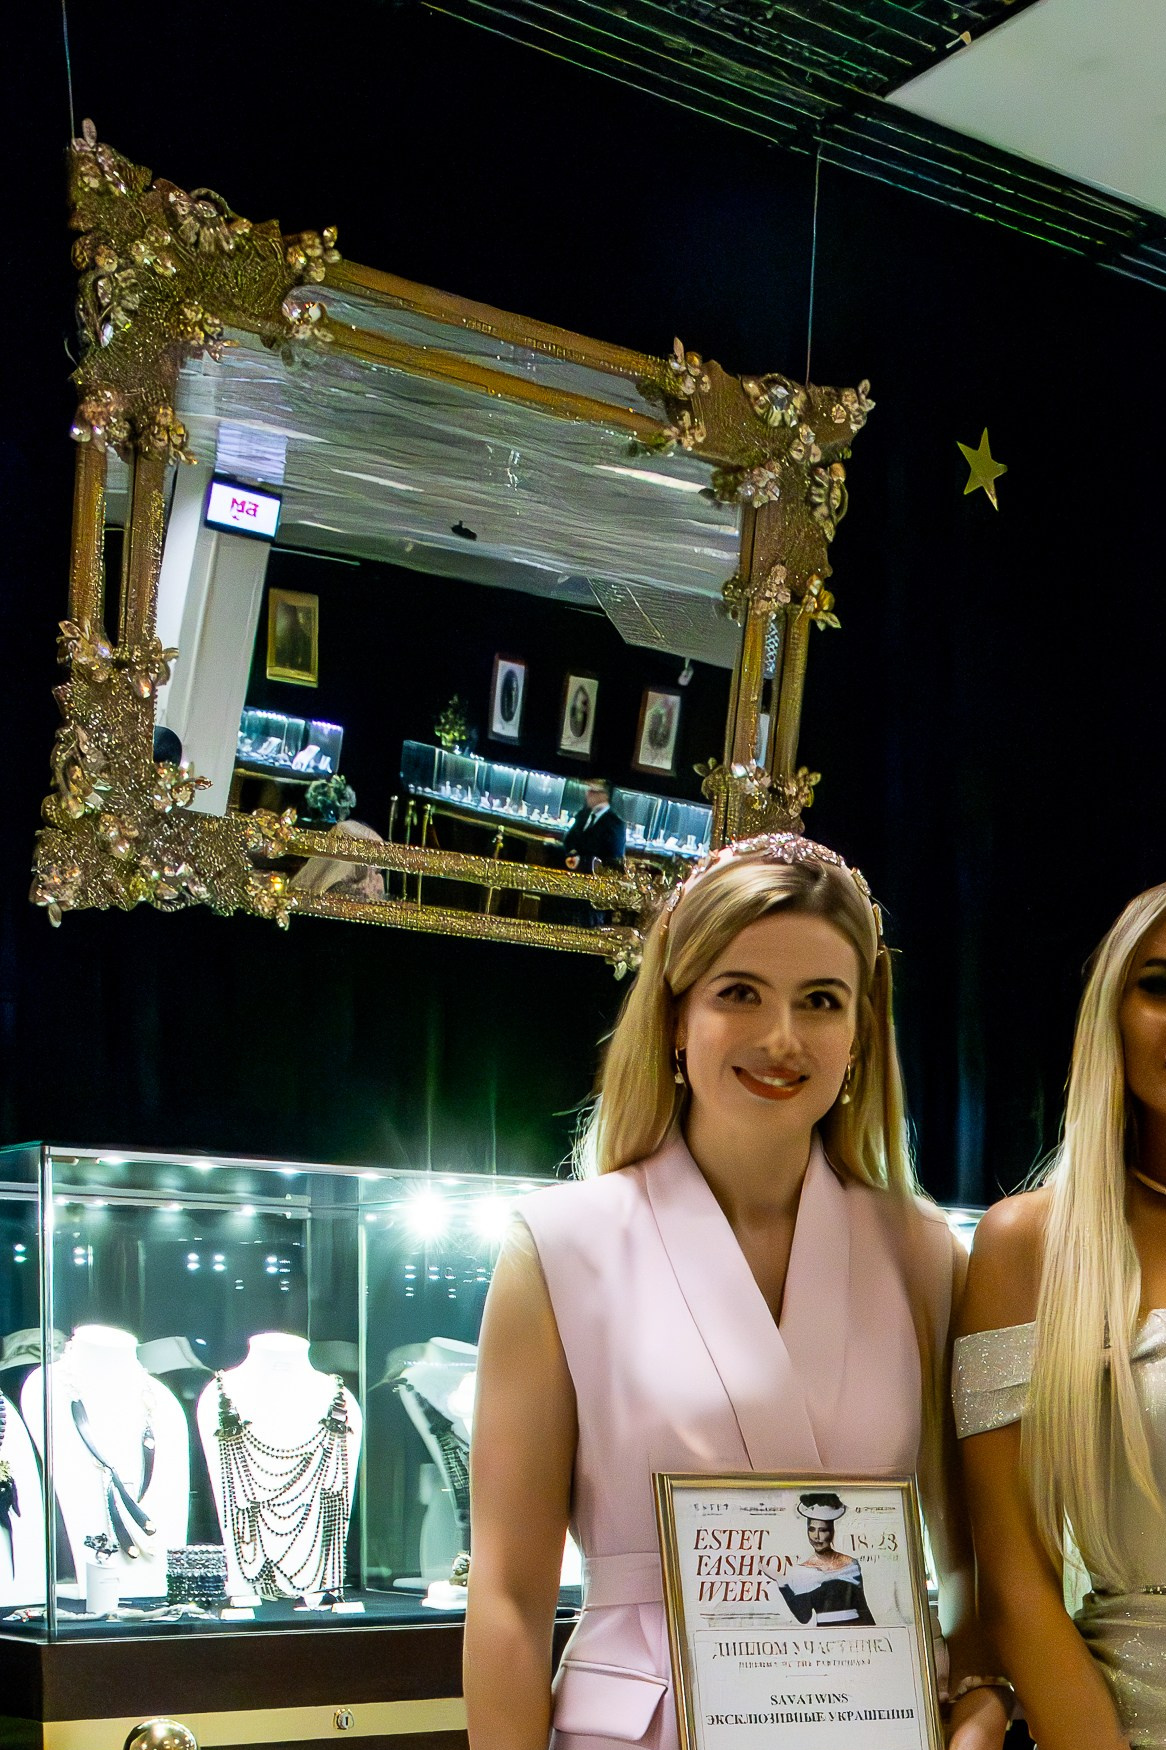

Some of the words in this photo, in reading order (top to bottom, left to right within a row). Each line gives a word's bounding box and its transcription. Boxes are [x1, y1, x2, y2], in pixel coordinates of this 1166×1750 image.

[693, 1528, 770, 1551] ESTET
[696, 1554, 801, 1577] FASHION
[698, 1581, 772, 1602] WEEK
